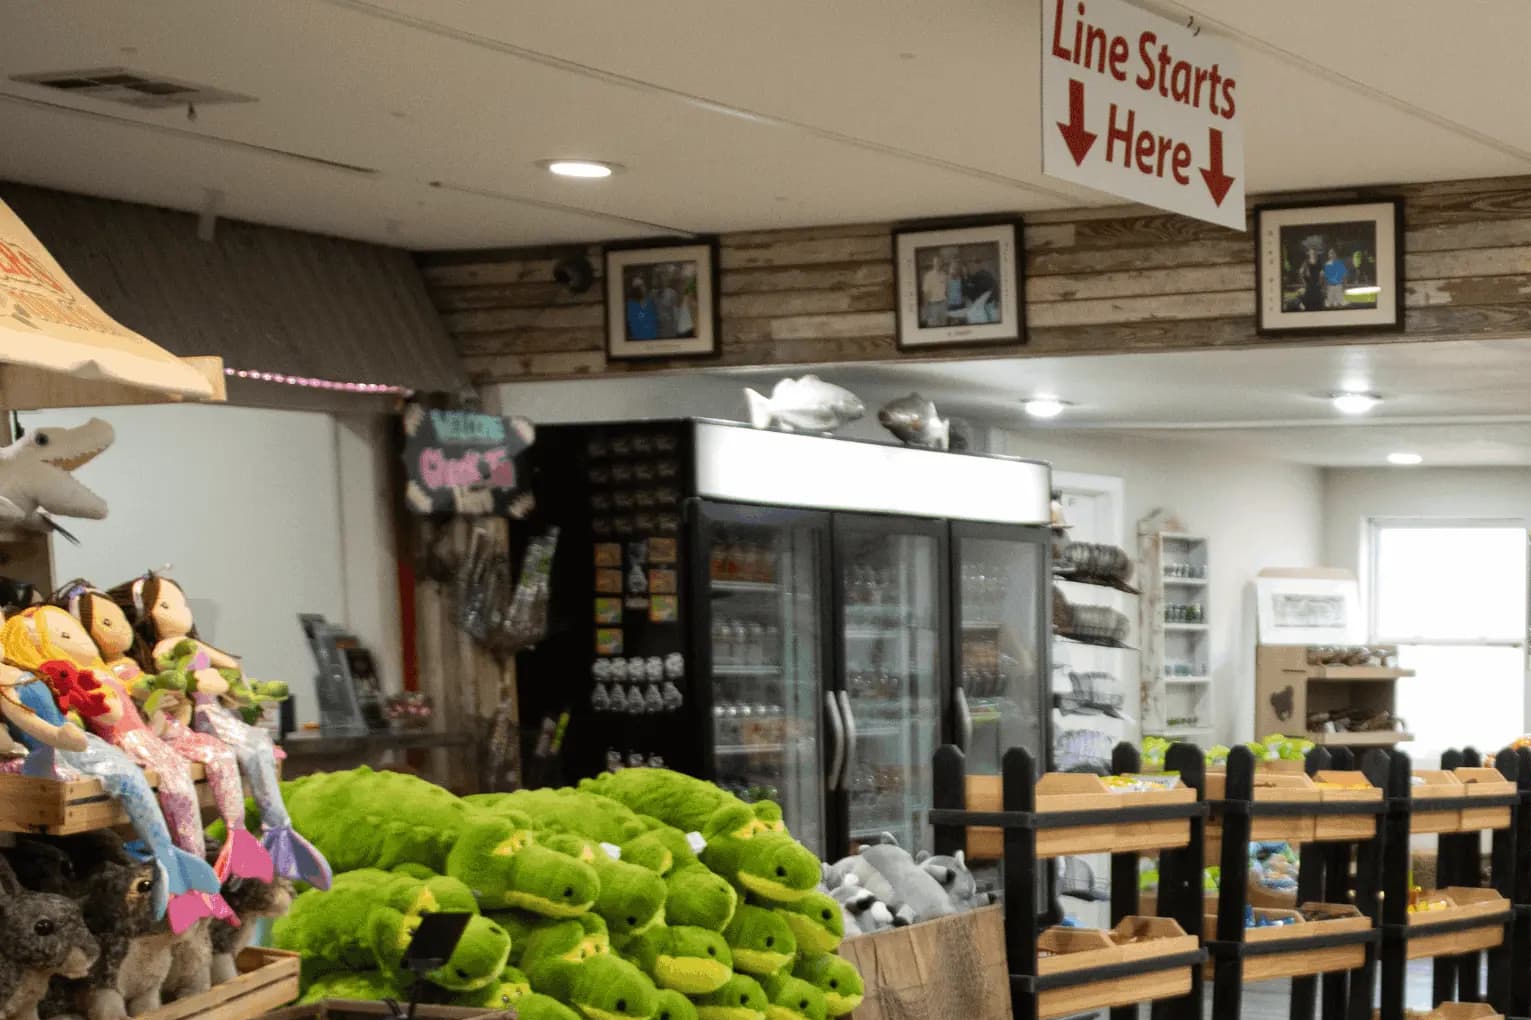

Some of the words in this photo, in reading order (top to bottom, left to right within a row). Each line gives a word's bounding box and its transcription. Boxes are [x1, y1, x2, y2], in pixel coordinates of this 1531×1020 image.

[1052, 0, 1129, 82] Line
[1136, 31, 1236, 120] Starts
[1105, 103, 1192, 186] Here
